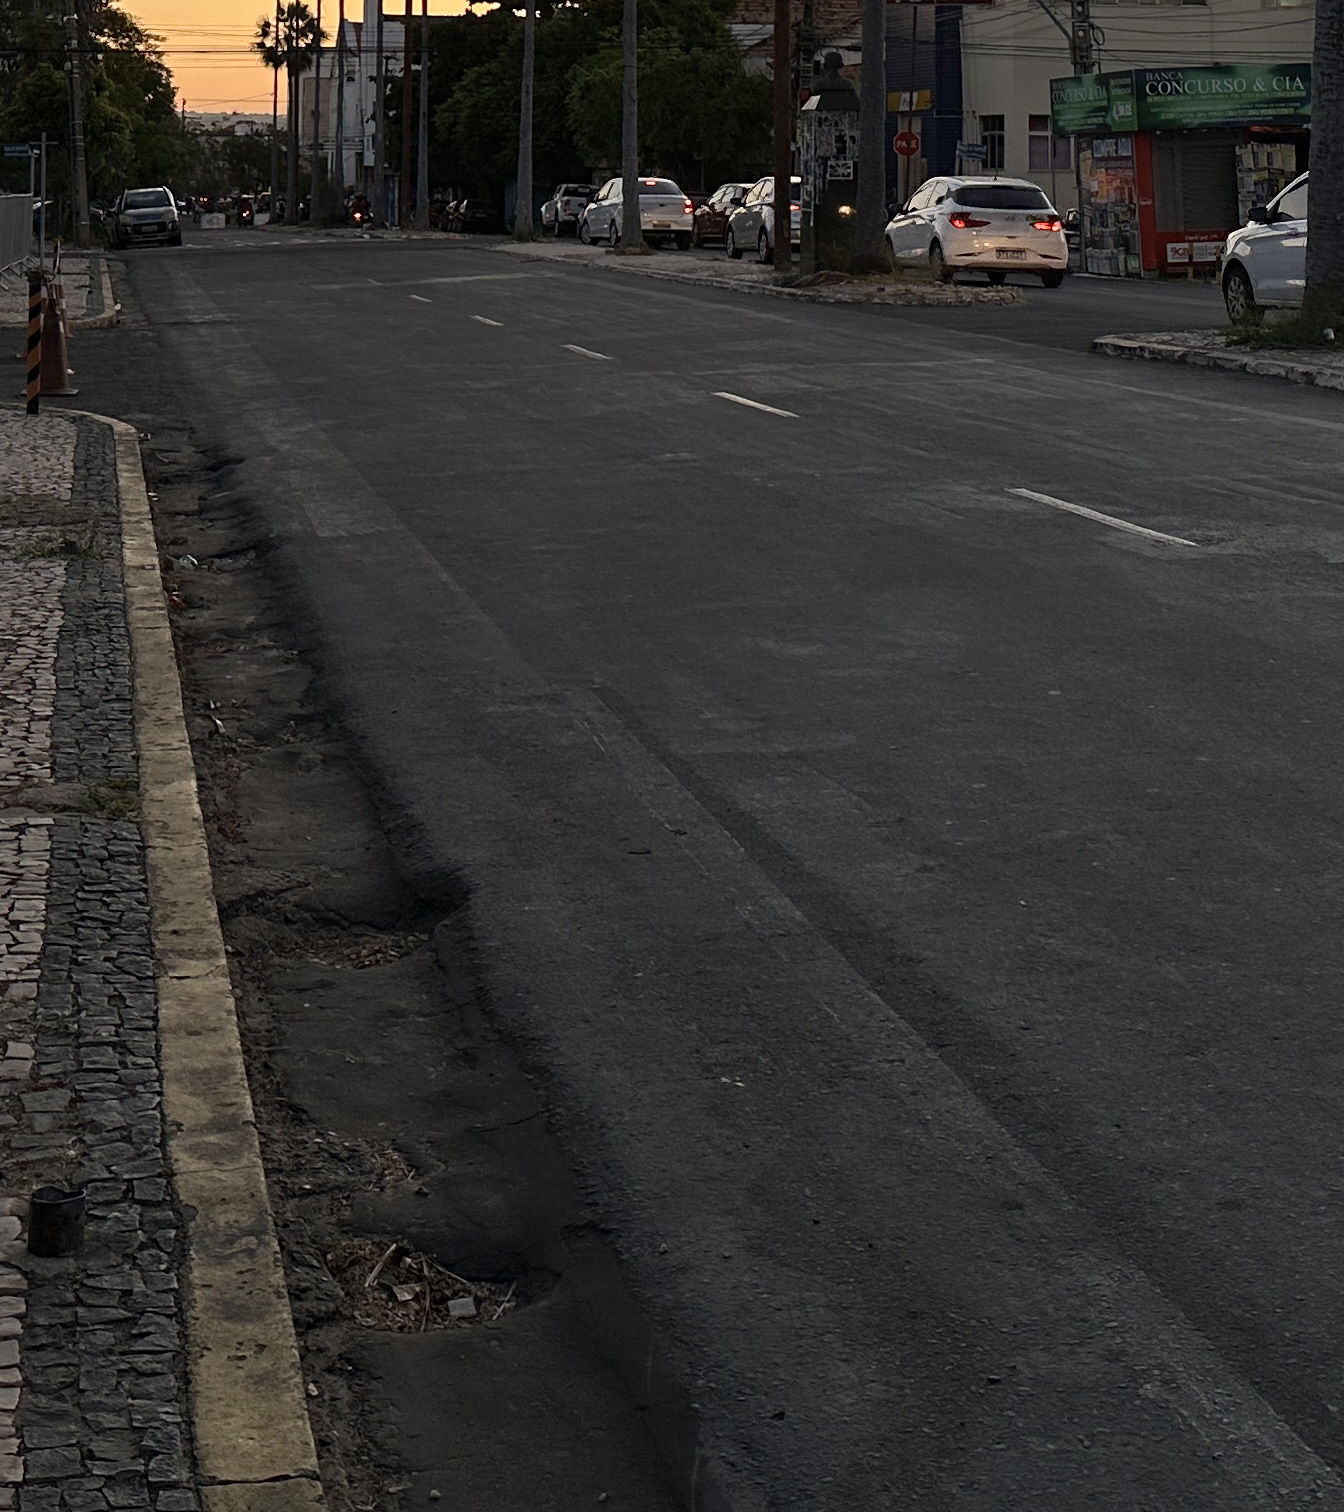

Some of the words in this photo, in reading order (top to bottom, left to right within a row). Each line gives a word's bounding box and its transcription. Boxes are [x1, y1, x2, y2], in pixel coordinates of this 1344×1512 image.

[1145, 72, 1183, 81] BANCA
[1145, 78, 1246, 96] CONCURSO
[1253, 77, 1266, 92] &
[1272, 75, 1304, 90] CIA
[896, 139, 918, 149] PAE
